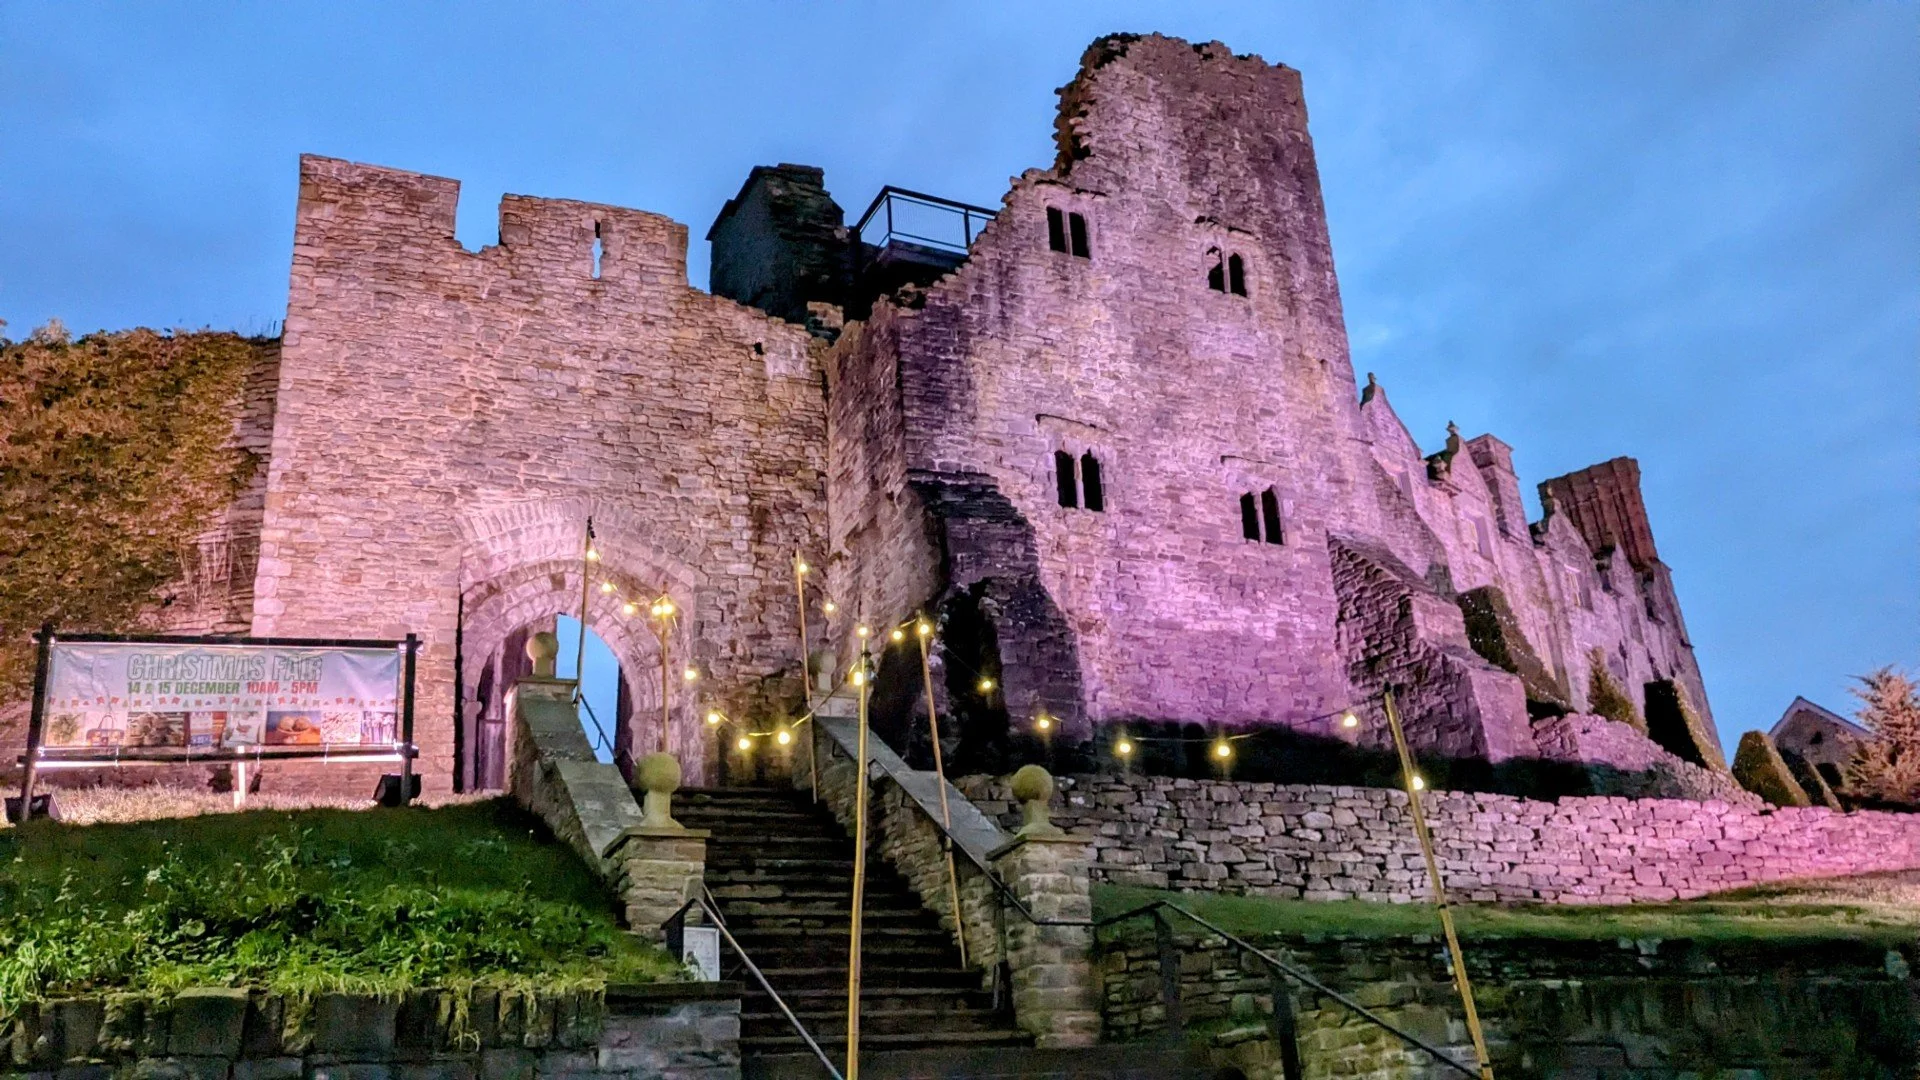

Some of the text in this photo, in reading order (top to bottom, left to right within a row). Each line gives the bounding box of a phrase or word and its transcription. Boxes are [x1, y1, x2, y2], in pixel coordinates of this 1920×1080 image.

[127, 653, 323, 681] CHRISTMAS FAIR
[128, 682, 141, 694] 14
[158, 682, 171, 694] 15
[175, 681, 240, 694] DECEMBER
[246, 682, 279, 694] 10AM
[291, 682, 318, 694] 5PM
